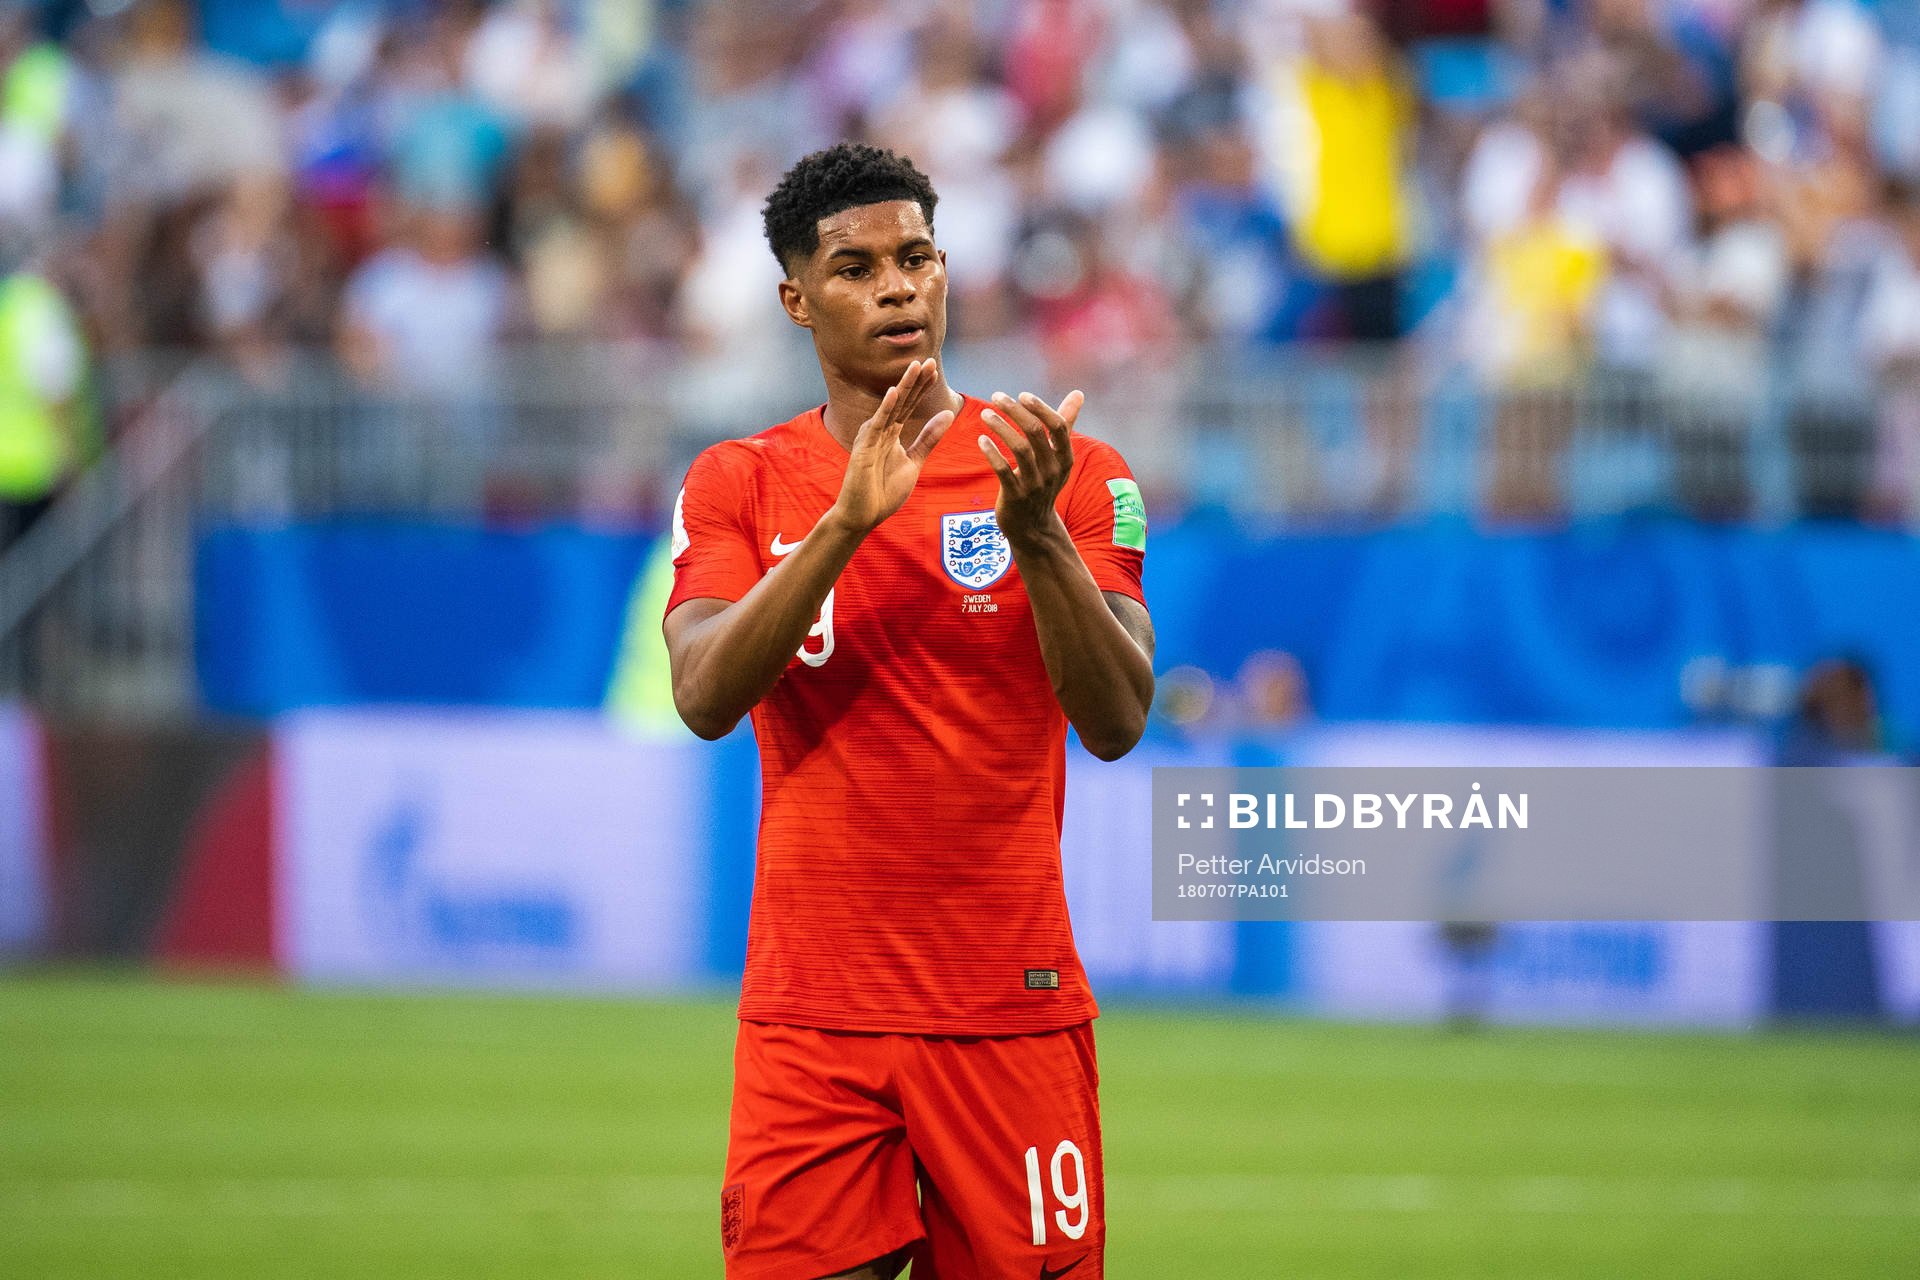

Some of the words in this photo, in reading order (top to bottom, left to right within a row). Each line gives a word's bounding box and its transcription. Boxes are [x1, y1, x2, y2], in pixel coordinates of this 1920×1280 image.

[963, 594, 991, 603] SWEDEN
[961, 604, 967, 613] 7
[967, 603, 982, 613] JULY
[983, 603, 998, 613] 2018
[1024, 1139, 1089, 1246] 19
